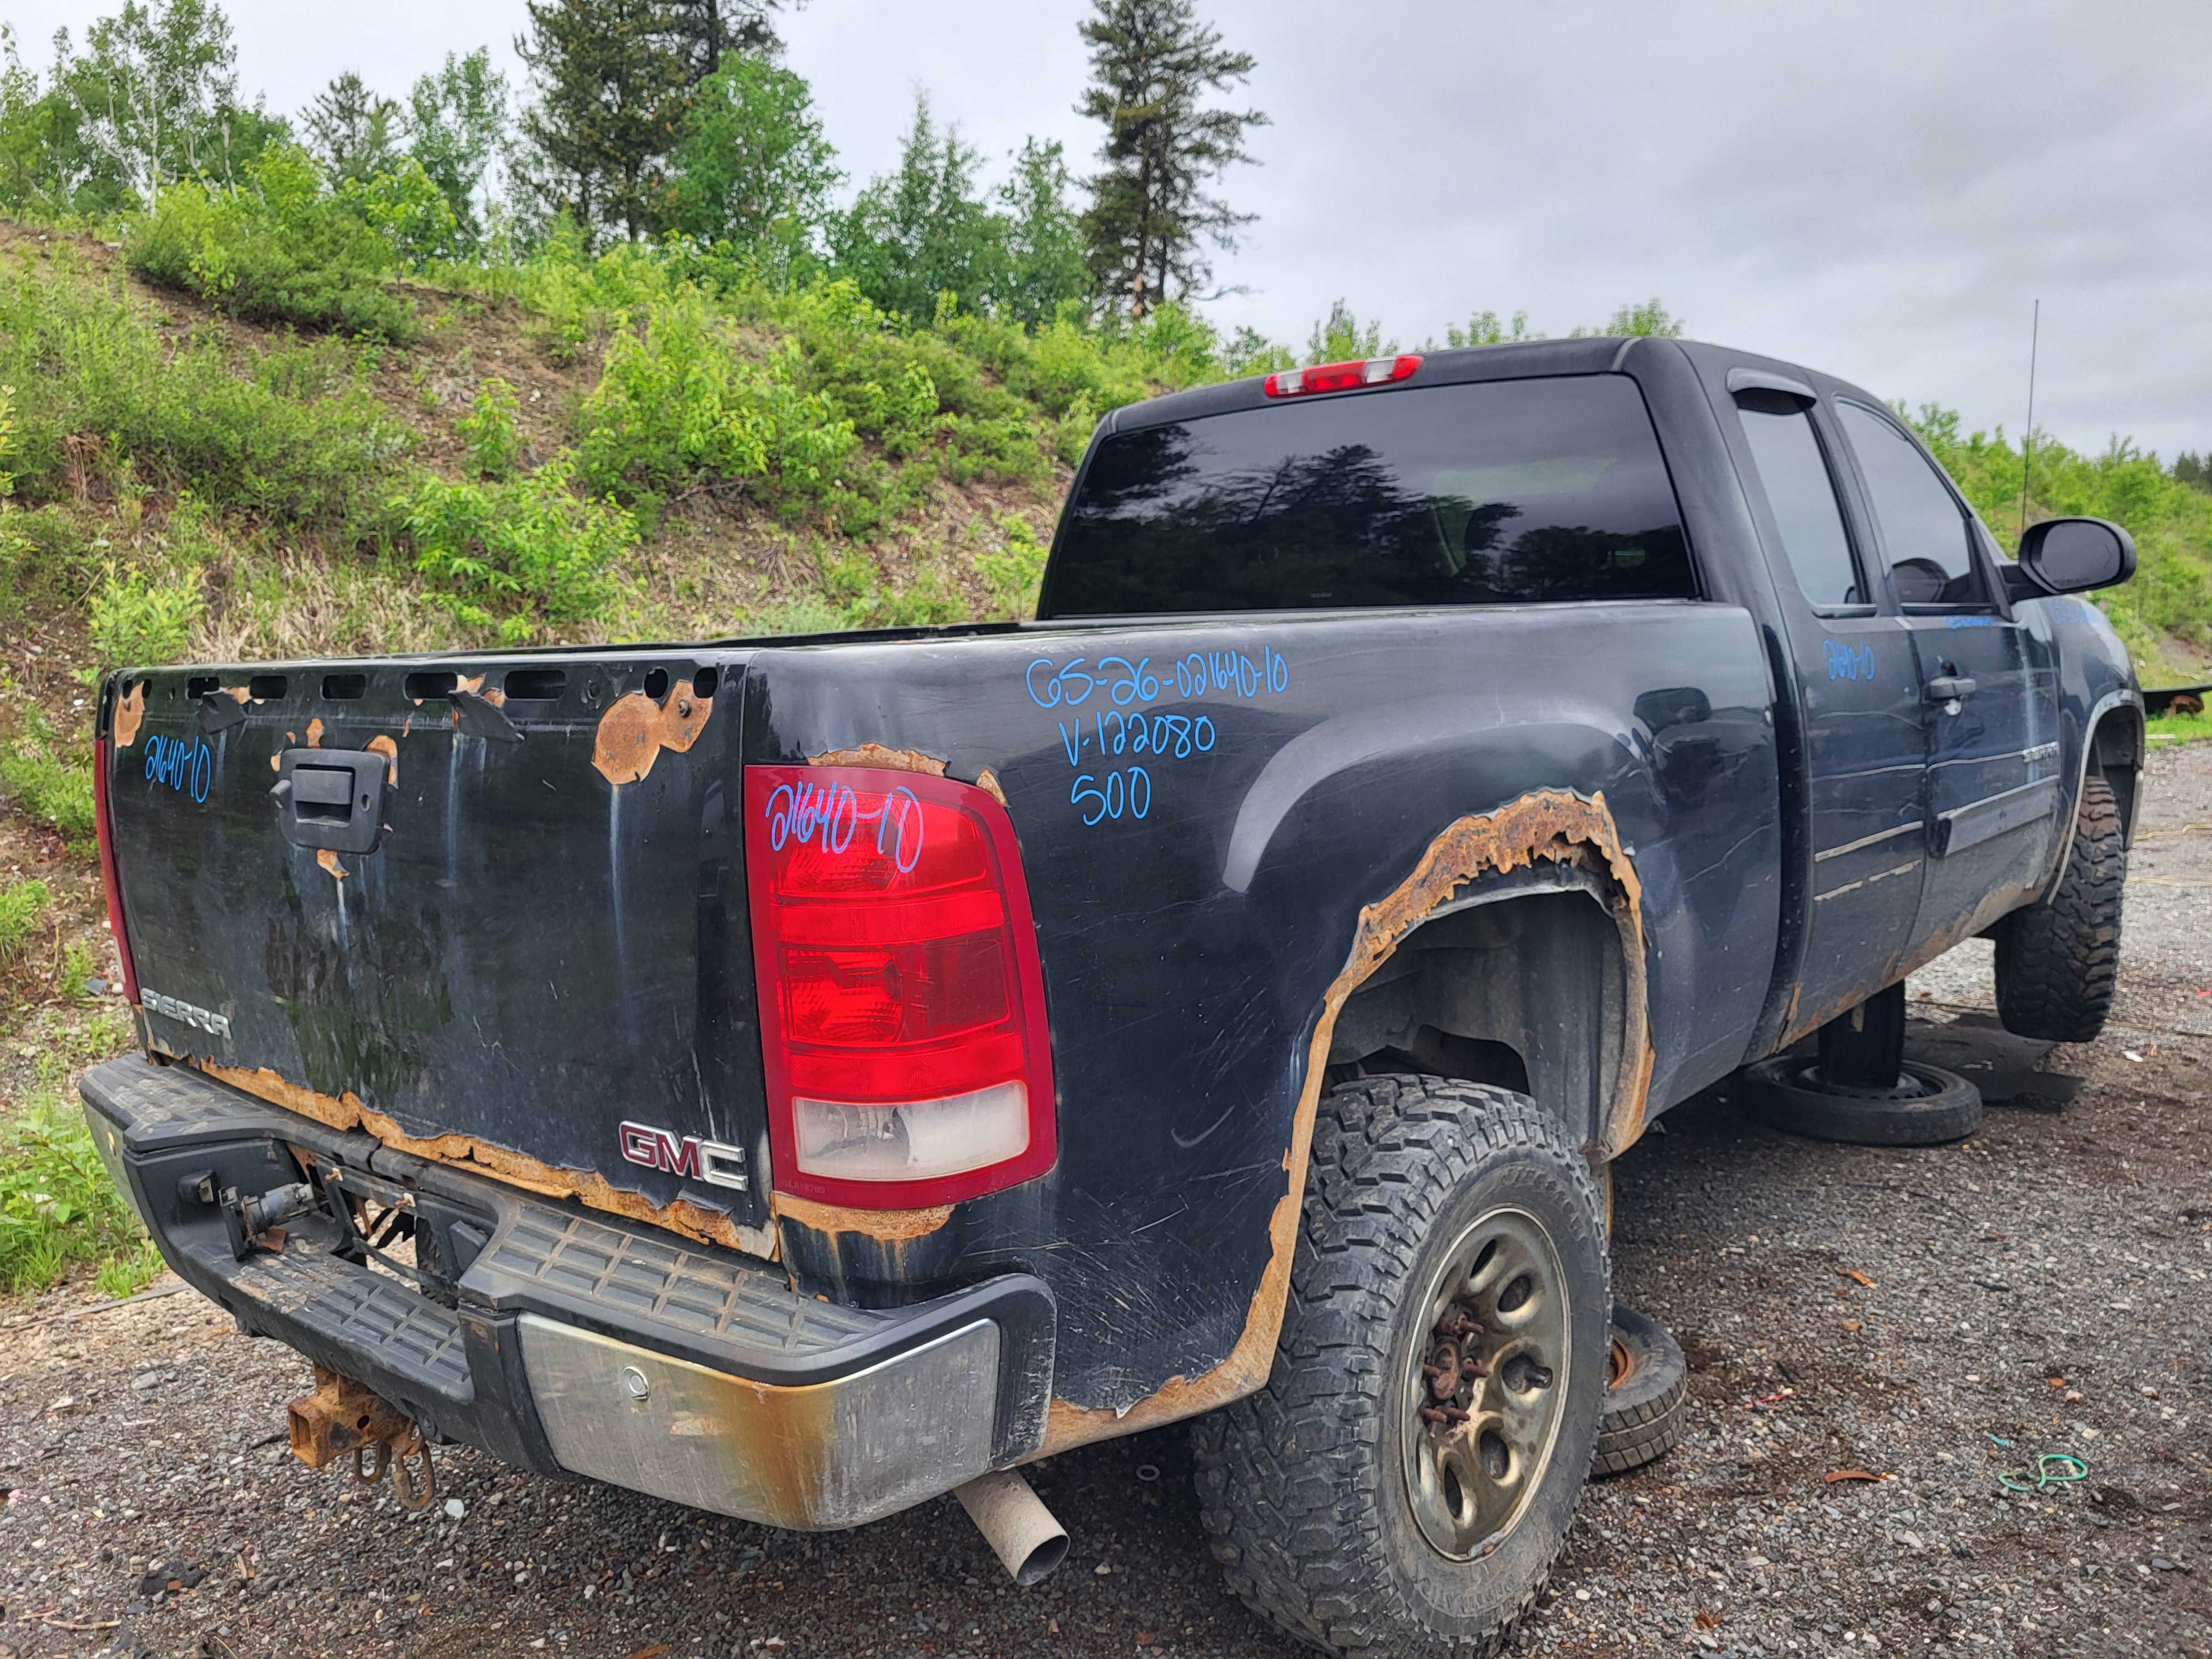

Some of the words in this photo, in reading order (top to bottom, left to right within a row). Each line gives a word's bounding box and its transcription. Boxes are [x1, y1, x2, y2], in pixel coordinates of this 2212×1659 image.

[765, 780, 924, 873] 21640-10
[1070, 765, 1152, 826] 500
[140, 987, 232, 1040] SIERRA
[618, 1120, 748, 1192] GMC
